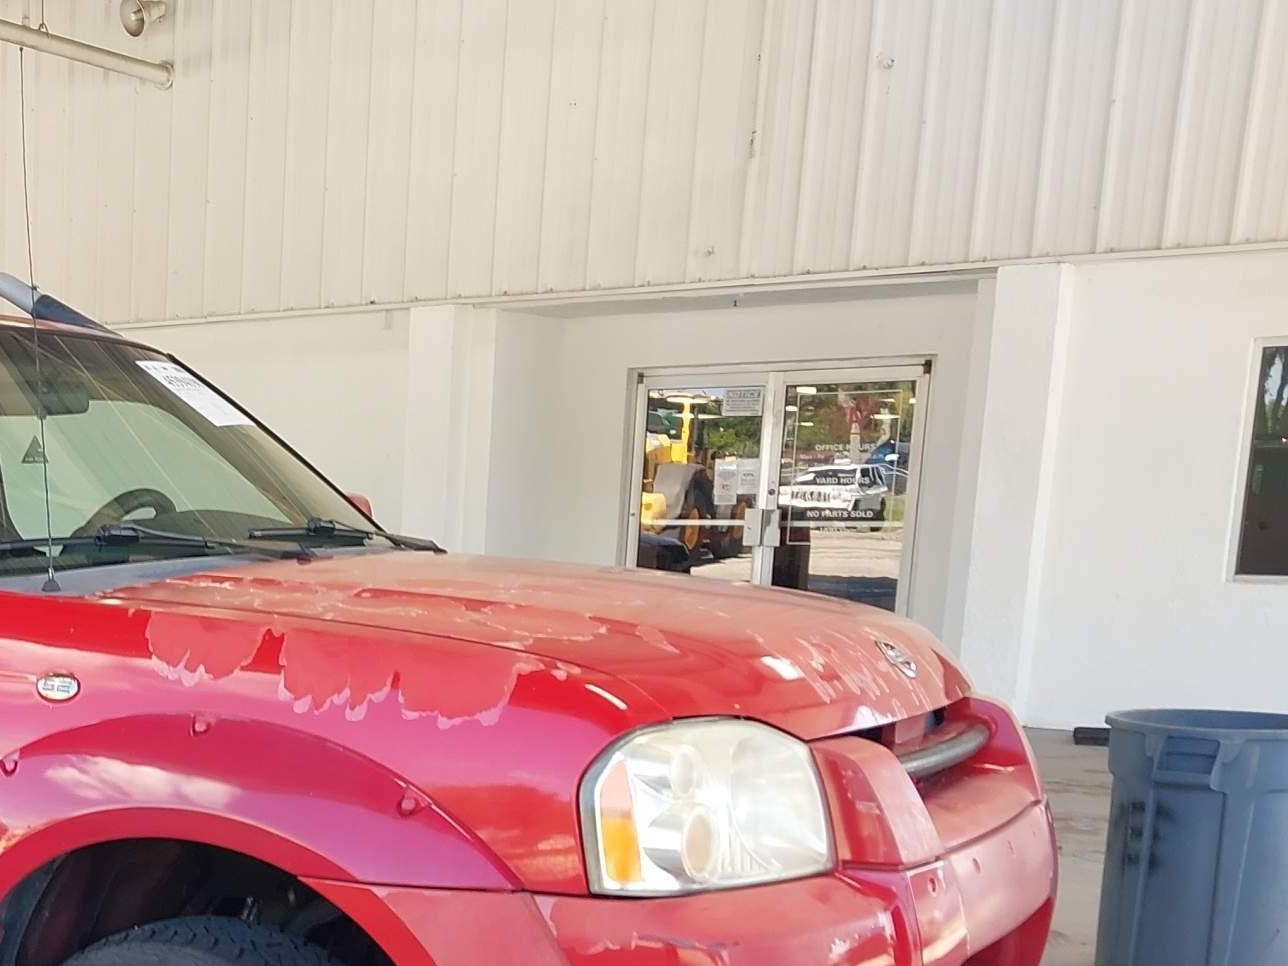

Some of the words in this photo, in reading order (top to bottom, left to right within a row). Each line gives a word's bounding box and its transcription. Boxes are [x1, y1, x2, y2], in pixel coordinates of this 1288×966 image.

[815, 476, 838, 485] YARD
[806, 510, 819, 518] NO
[822, 509, 849, 518] PARTS
[850, 510, 874, 518] SOLD
